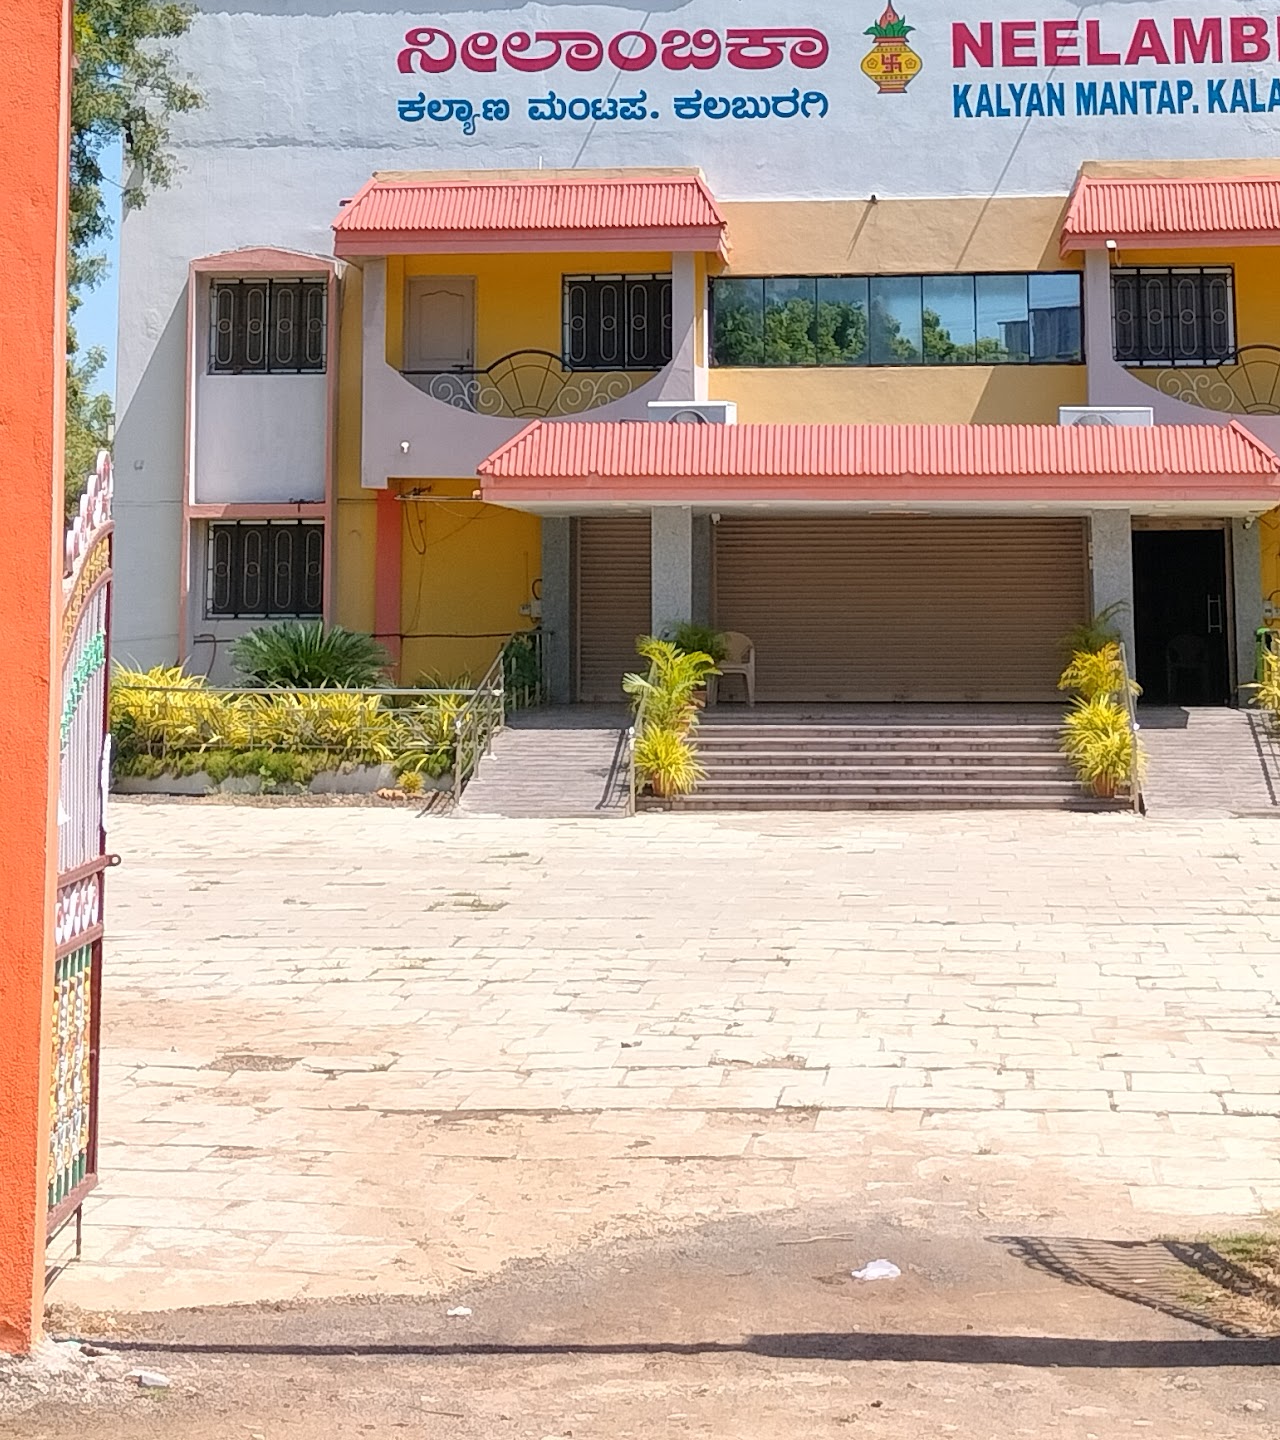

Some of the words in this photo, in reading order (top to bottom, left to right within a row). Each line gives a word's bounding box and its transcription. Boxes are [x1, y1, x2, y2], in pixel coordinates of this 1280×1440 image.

[398, 28, 827, 72] ನೀಲಾಂಬಿಕಾ
[396, 91, 509, 134] ಕಲ್ಯಾಣ
[527, 89, 659, 120] ಮಂಟಪ.
[672, 88, 828, 119] ಕಲಬುರಗಿ
[952, 82, 1065, 118] KALYAN
[1075, 79, 1198, 116] MANTAP.
